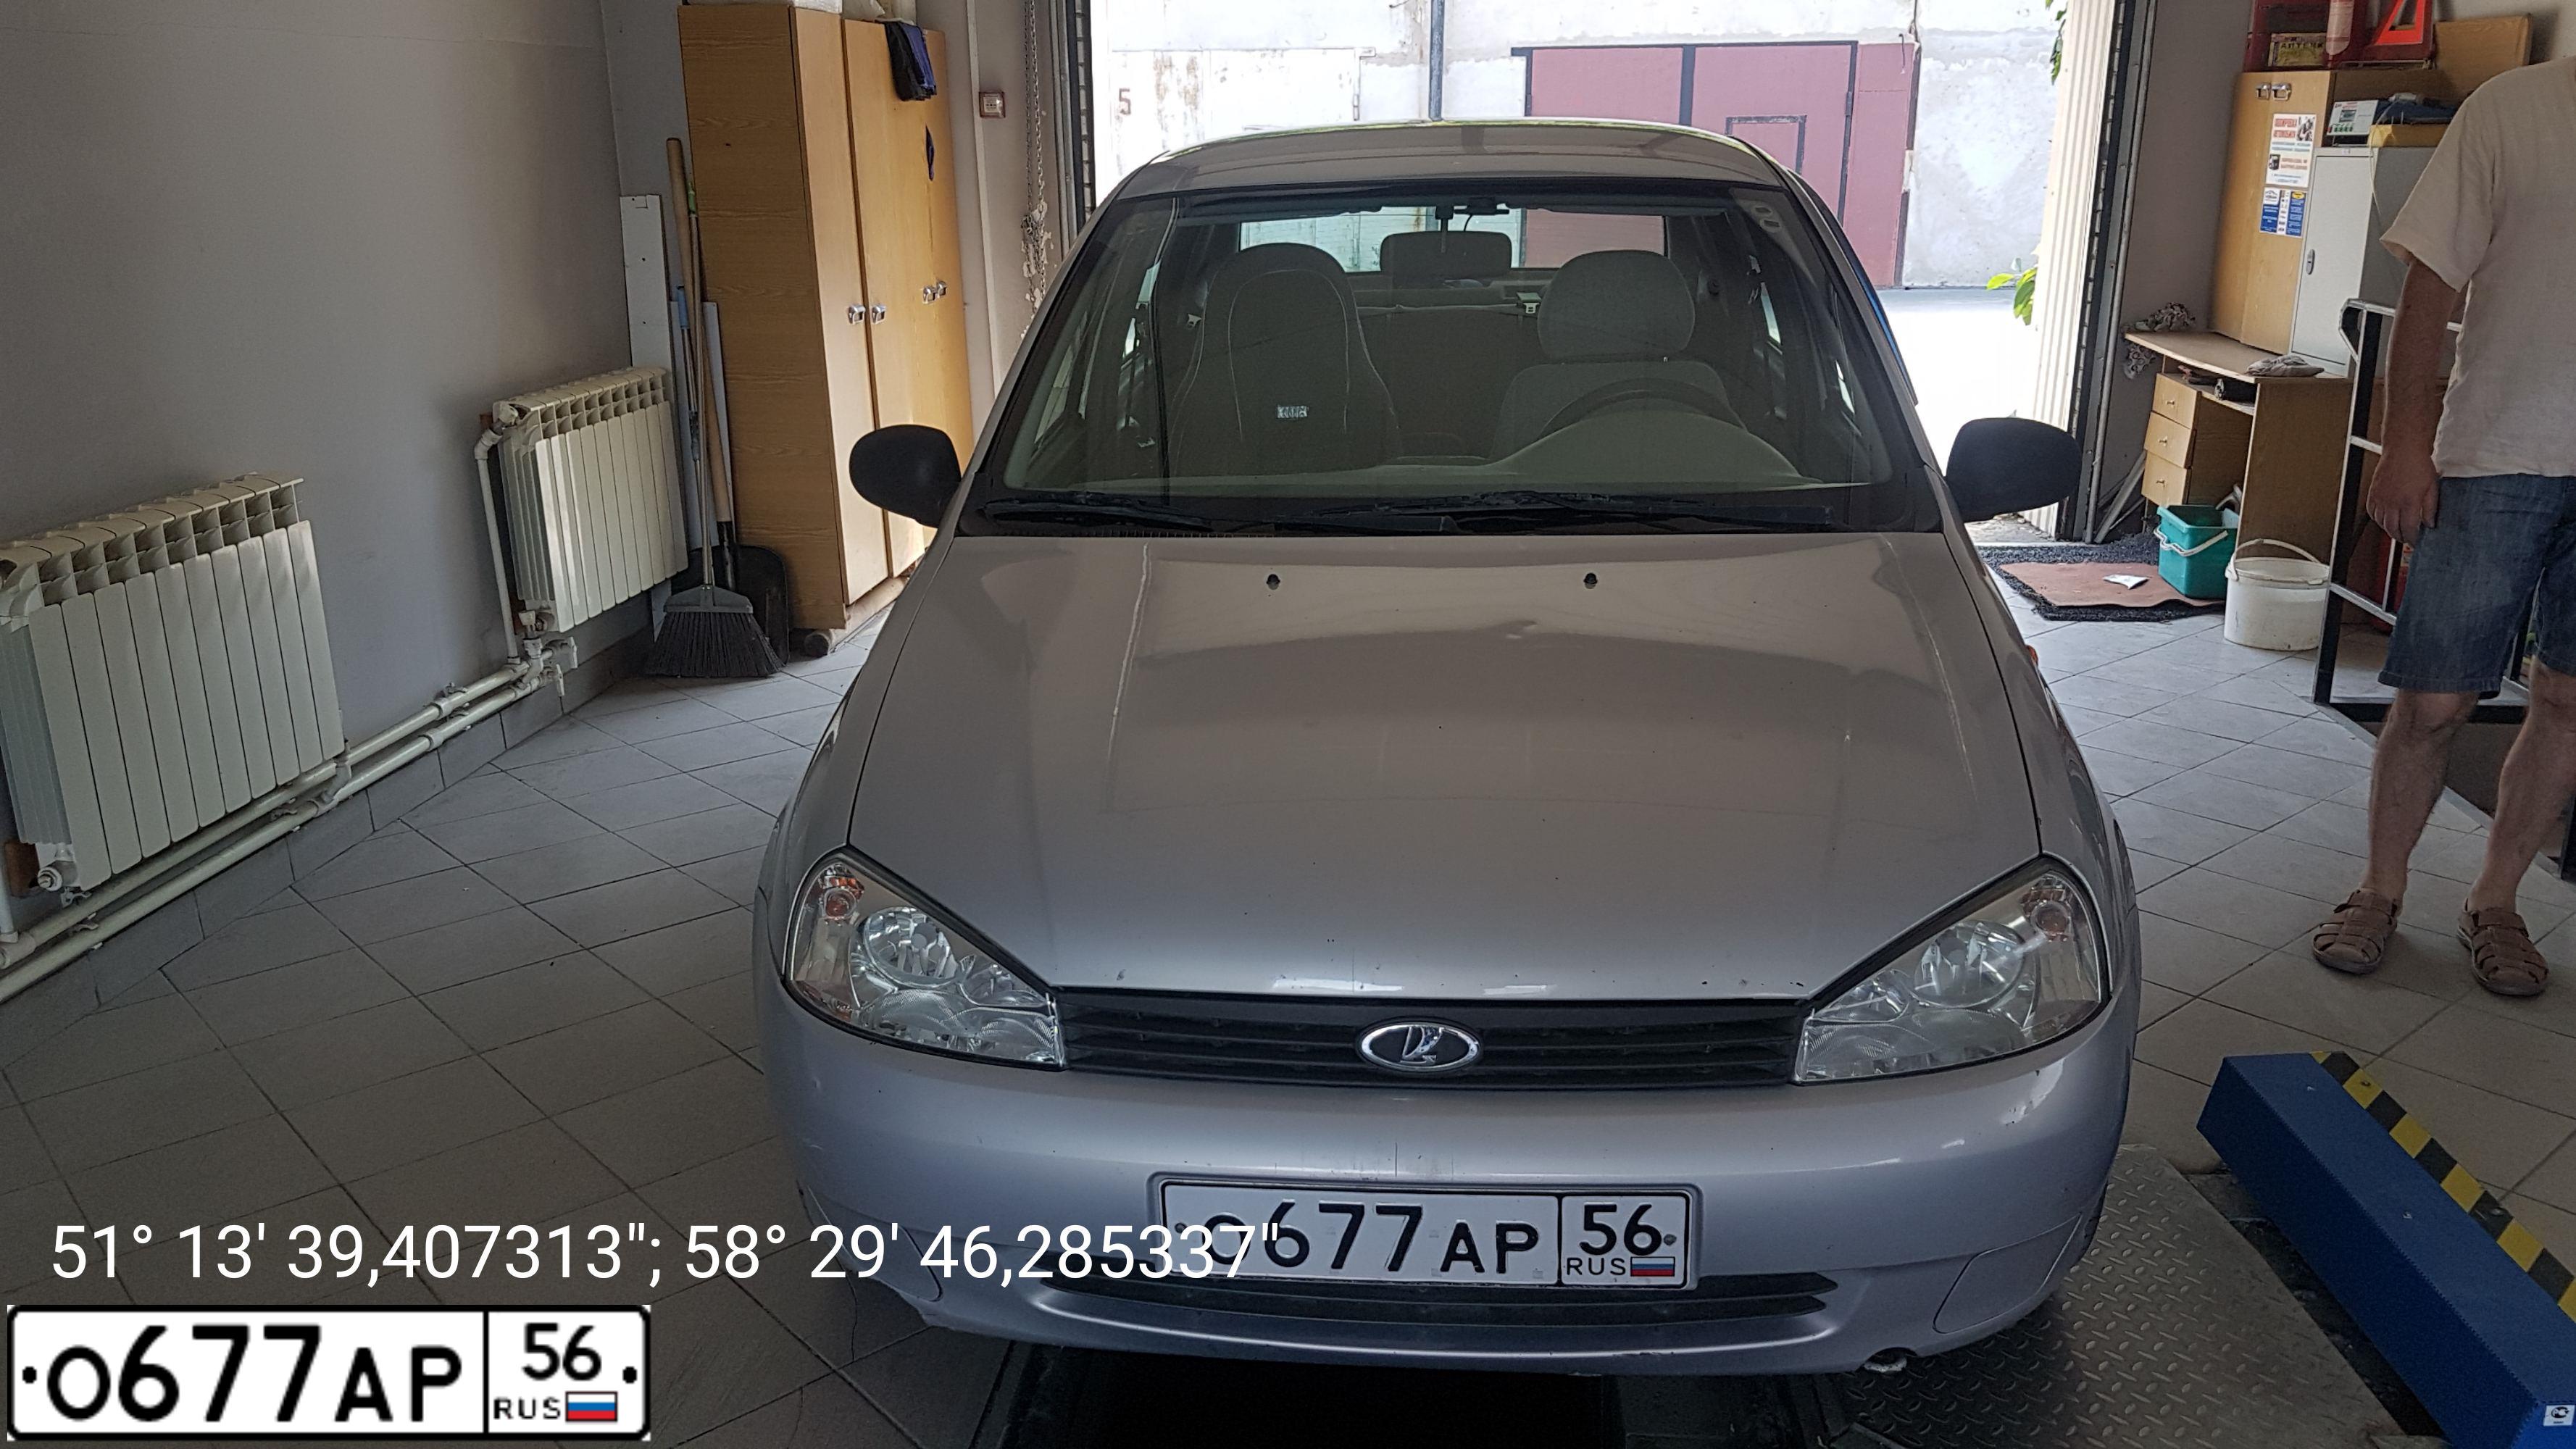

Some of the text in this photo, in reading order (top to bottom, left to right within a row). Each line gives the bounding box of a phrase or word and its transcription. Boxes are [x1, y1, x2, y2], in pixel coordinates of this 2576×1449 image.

[1118, 88, 1131, 115] 5
[1579, 1203, 1662, 1256] 56
[1566, 1257, 1627, 1277] RUS
